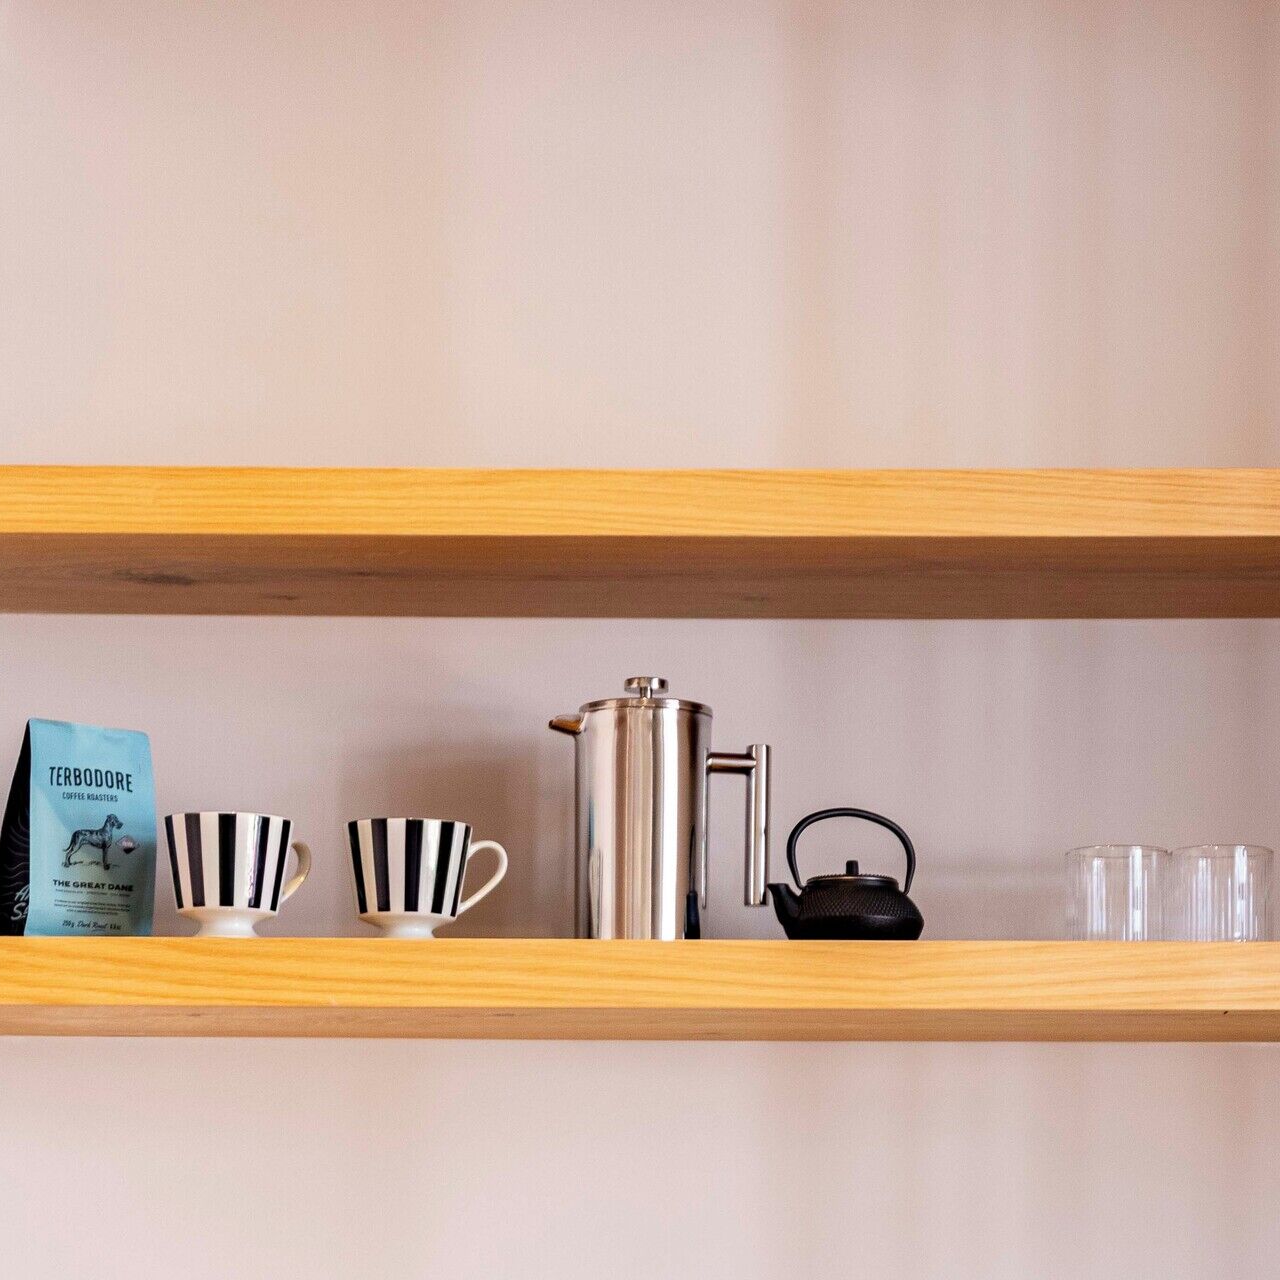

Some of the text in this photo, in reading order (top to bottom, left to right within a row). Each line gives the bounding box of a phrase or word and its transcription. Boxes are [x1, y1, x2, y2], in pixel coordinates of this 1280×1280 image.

[49, 766, 133, 793] TERBODORE
[62, 791, 119, 802] COFFEE ROASTERS
[53, 879, 134, 892] THE GREAT DANE
